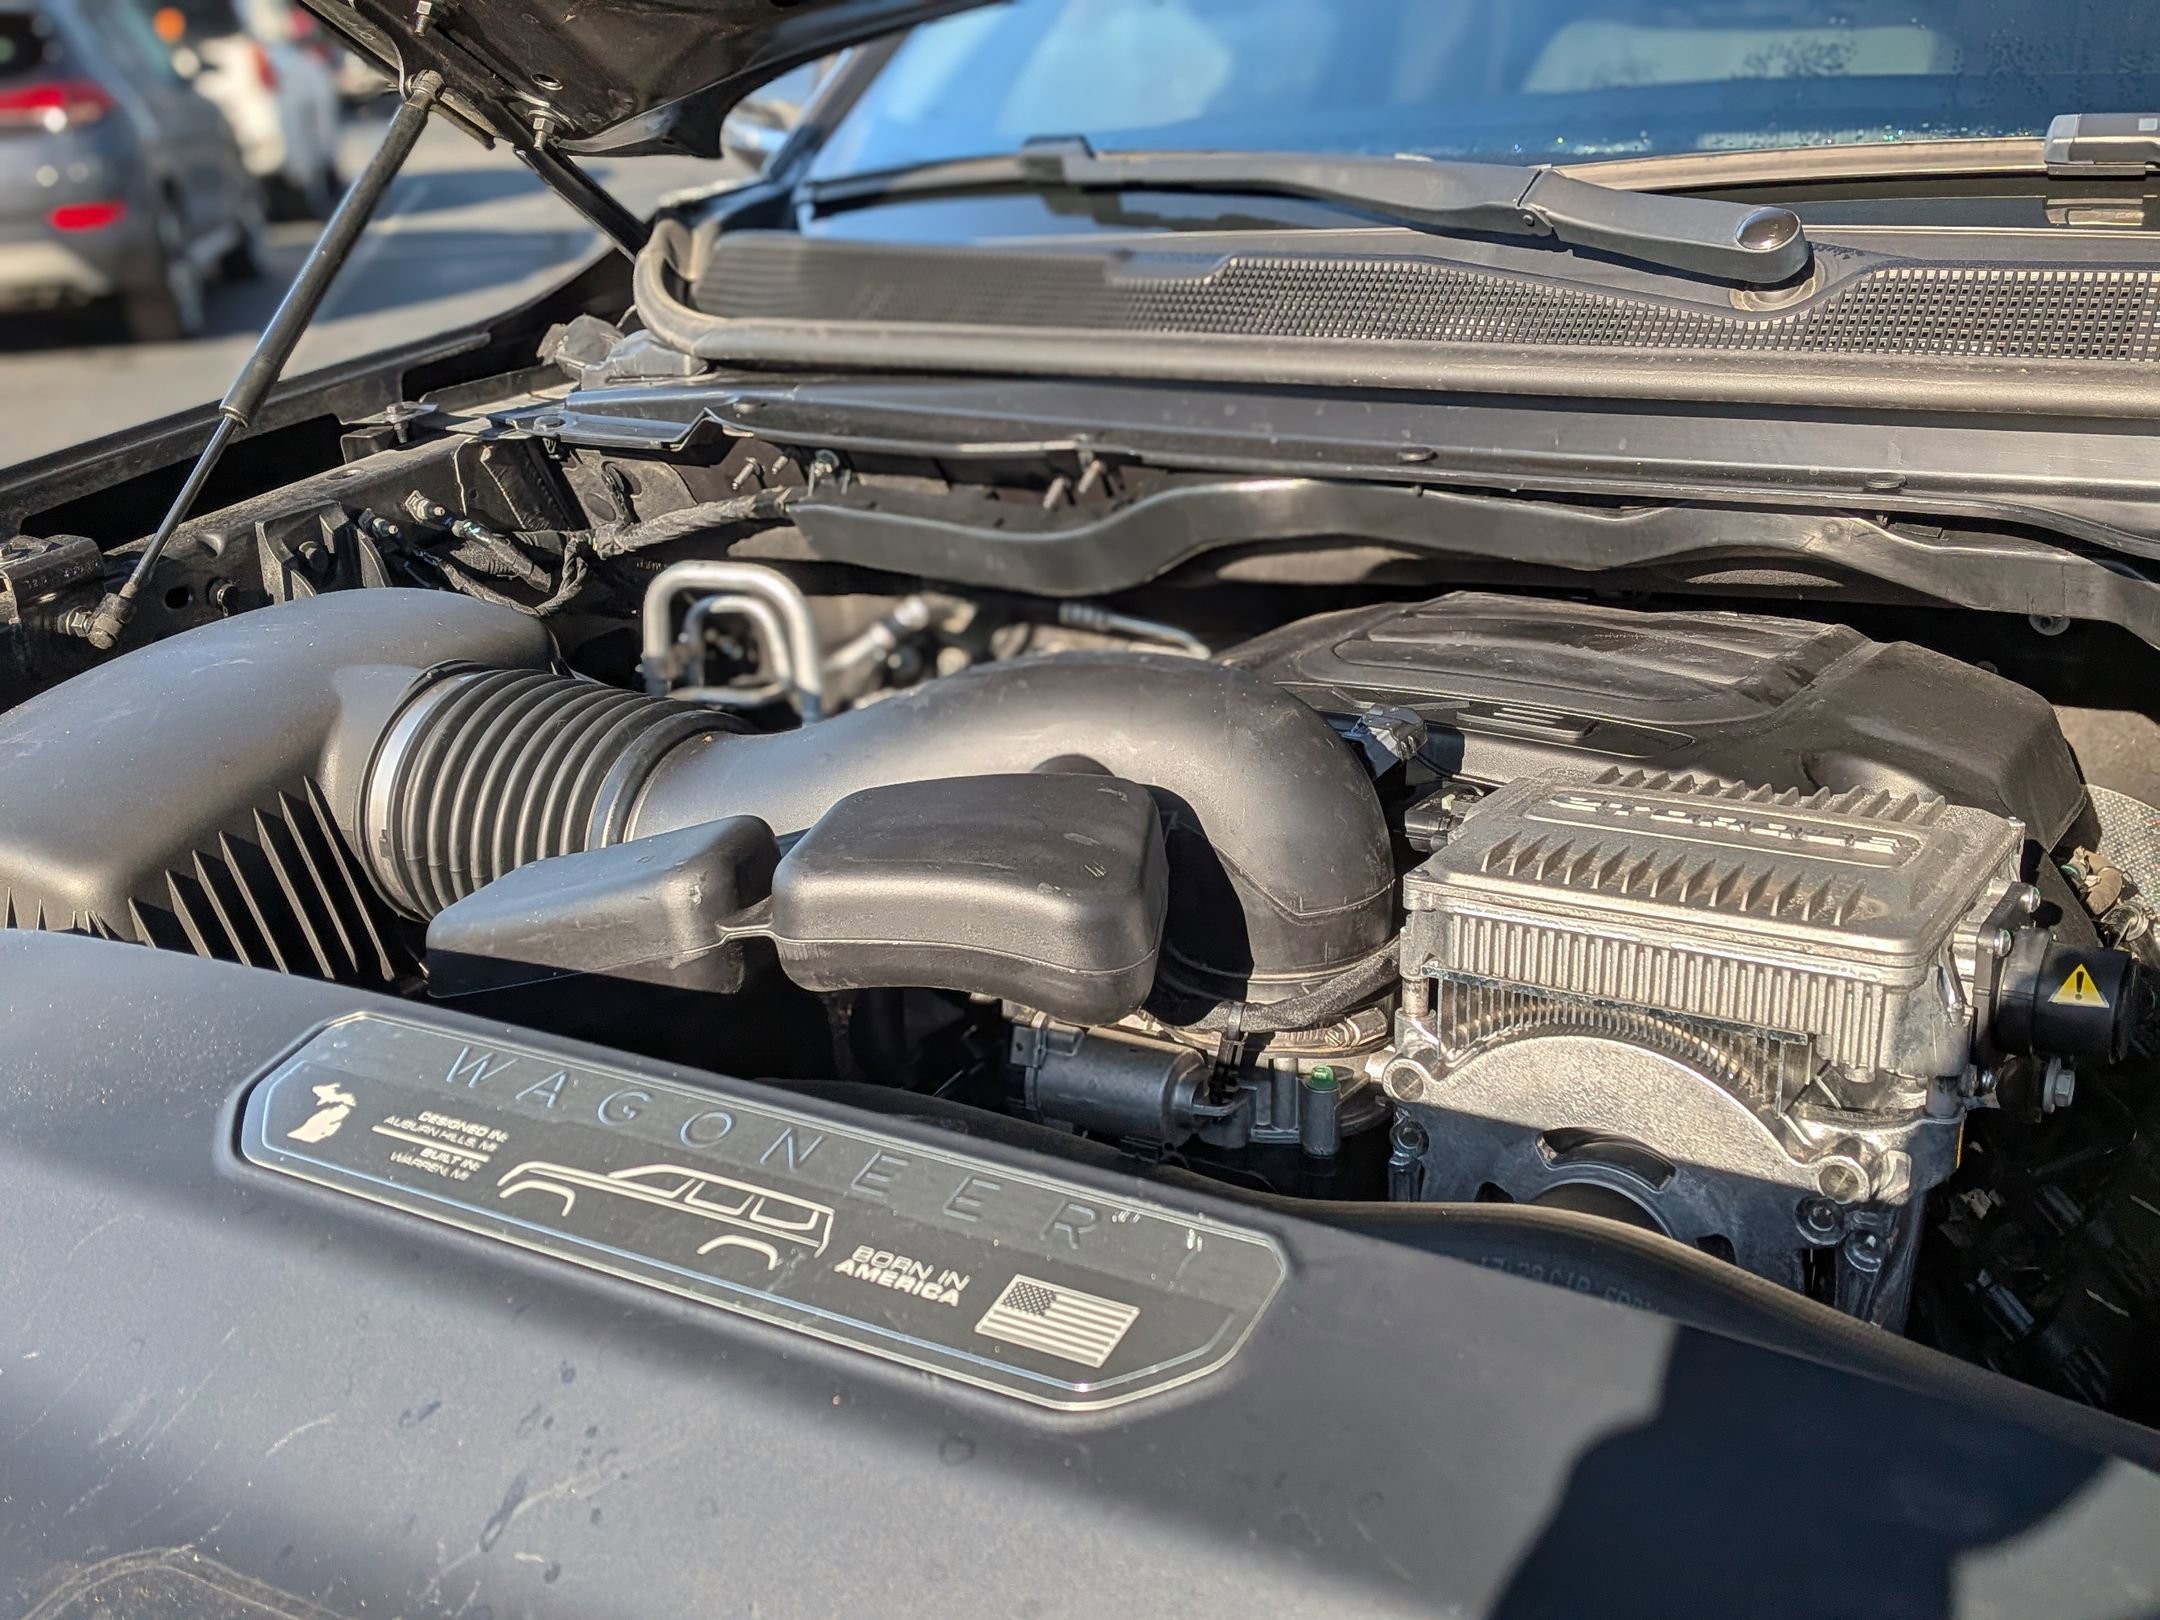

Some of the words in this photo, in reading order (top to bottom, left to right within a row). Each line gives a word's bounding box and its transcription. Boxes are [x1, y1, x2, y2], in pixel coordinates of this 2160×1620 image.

[383, 1114, 440, 1138] AUBURN
[477, 1139, 498, 1153] MI
[418, 1110, 490, 1138] DESIGNED
[420, 1146, 462, 1166] BUILT
[445, 1045, 1098, 1250] WAGONEER
[450, 1166, 471, 1181] MI
[833, 1258, 960, 1308] AMERICA
[851, 1245, 935, 1280] BORN
[937, 1269, 971, 1291] IN
